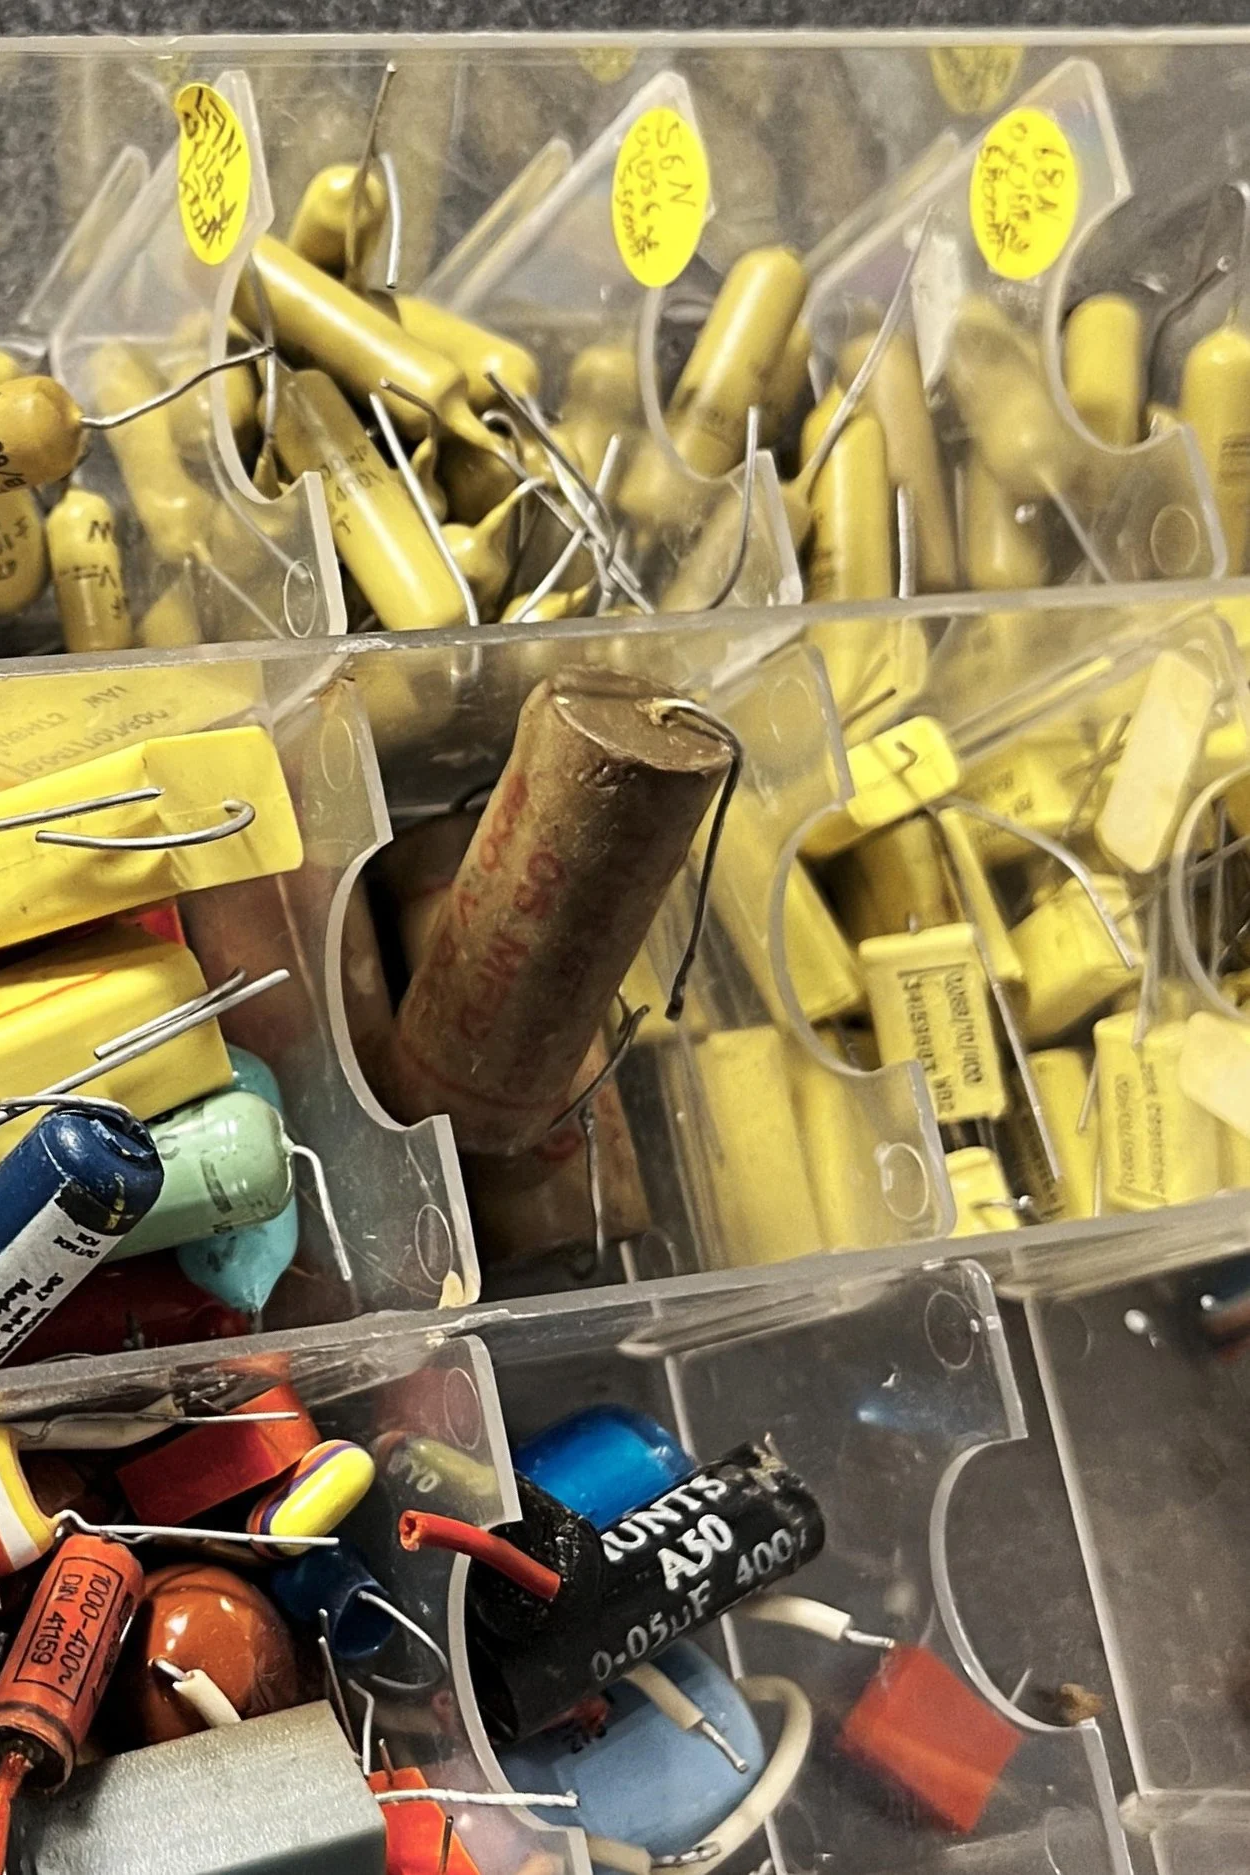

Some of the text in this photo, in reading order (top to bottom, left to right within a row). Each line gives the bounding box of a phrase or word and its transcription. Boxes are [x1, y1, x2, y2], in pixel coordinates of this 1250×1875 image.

[657, 112, 697, 207] 56N
[31, 1574, 83, 1665] DIN 41159
